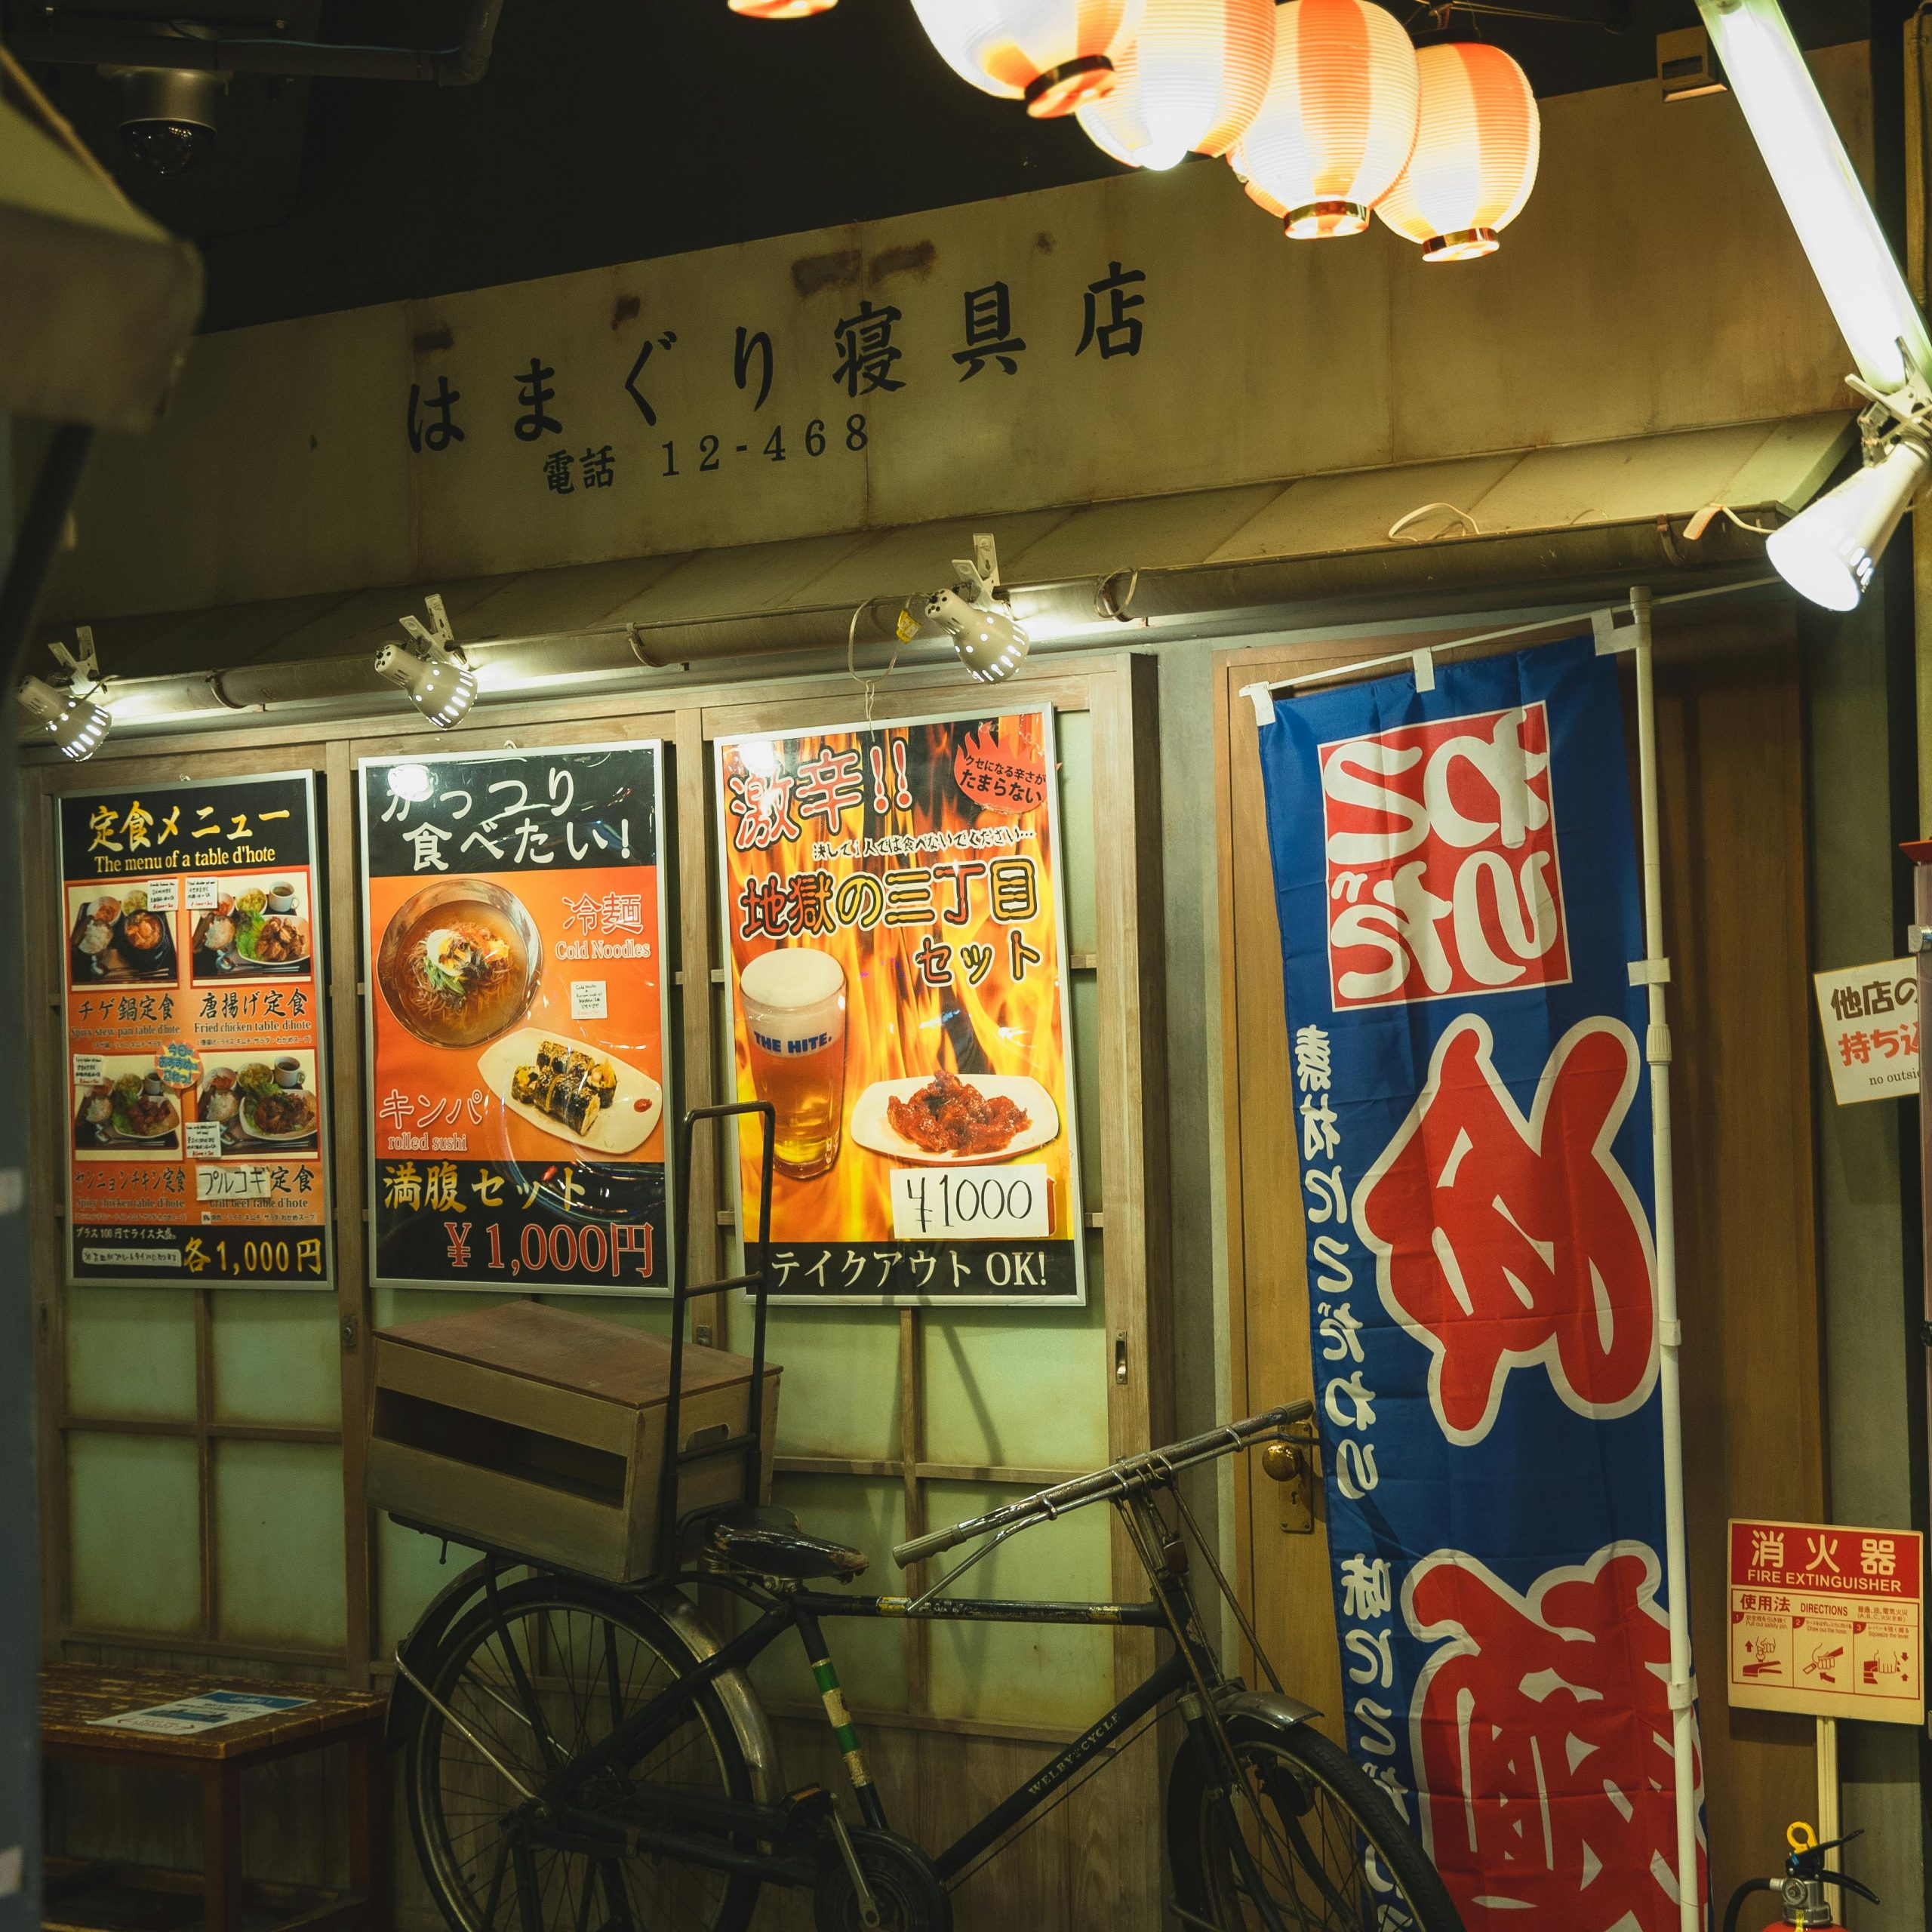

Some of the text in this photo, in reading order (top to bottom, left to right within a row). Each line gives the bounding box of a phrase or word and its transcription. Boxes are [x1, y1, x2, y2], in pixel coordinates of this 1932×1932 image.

[408, 261, 1146, 453] はまぐり寝具店
[543, 414, 868, 495] 電話 12-468
[960, 769, 1042, 804] たまらない
[966, 755, 1046, 786] クセになる辛さが
[87, 801, 291, 852] 定食メニュー
[94, 846, 276, 873] The menu of a table d'hote
[403, 818, 631, 872] 食べたい!
[739, 855, 1040, 941] 地獄の三丁目
[555, 938, 651, 961] Cold Noodles
[913, 927, 1044, 987] セット
[78, 993, 174, 1021] チゲ鍋定食
[199, 988, 308, 1019] 唐揚げ定食
[1830, 977, 1918, 1021] 他店の
[118, 1026, 134, 1038] pan
[194, 1019, 311, 1033] Fried chicken table d'hote
[754, 1031, 782, 1054] THE
[1869, 1076, 1884, 1085] no
[380, 1088, 483, 1129] キンパ
[388, 1133, 468, 1151] rolled sushi
[383, 1161, 586, 1214] 満腹セット
[771, 1250, 1048, 1287] テイクアウト OK!
[1751, 1530, 1896, 1576] 消火器
[1747, 1569, 1902, 1592] FIRE EXTINGUISHER
[1740, 1594, 1791, 1612] 使用法
[1800, 1603, 1848, 1617] DIRECTIONS
